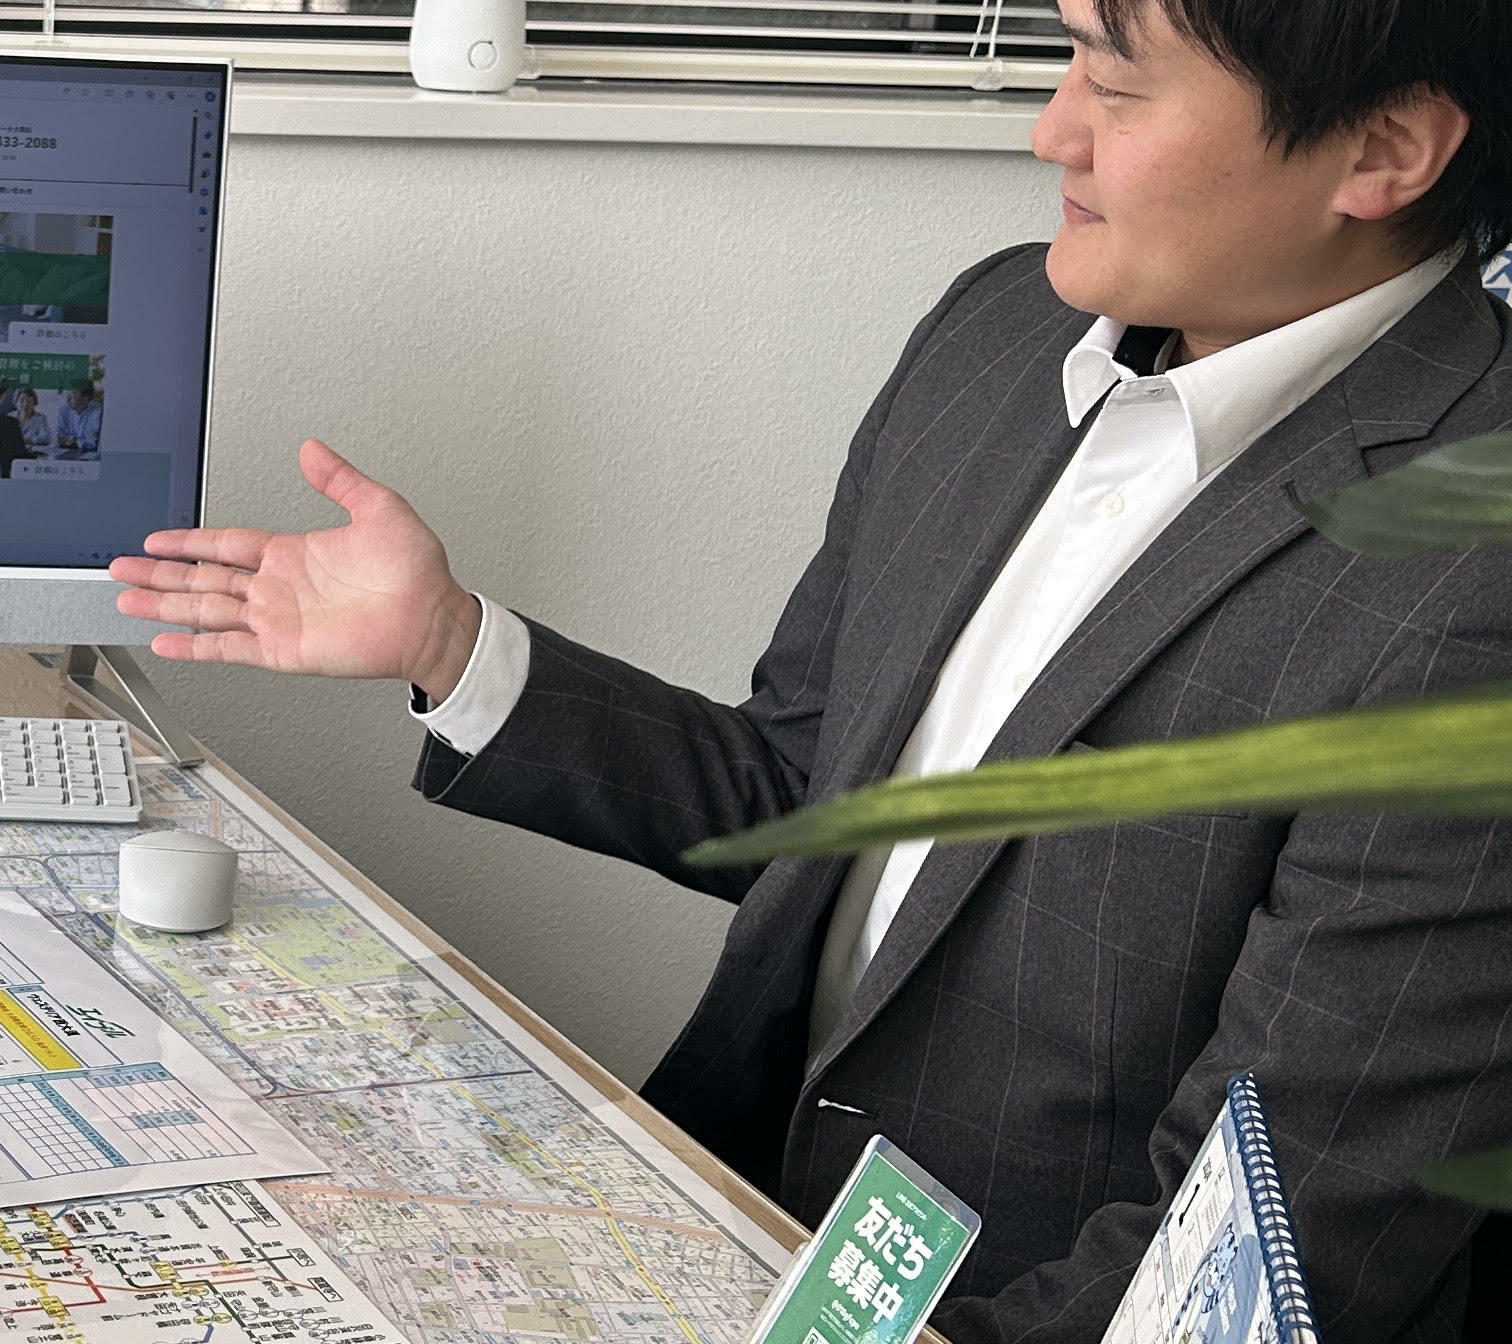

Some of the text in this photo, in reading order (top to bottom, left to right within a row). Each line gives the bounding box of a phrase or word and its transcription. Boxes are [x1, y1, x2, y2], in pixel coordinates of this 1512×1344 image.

[64, 1002, 136, 1039] エイブル
[853, 1195, 934, 1280] 友だち
[827, 1239, 905, 1324] 募集中
